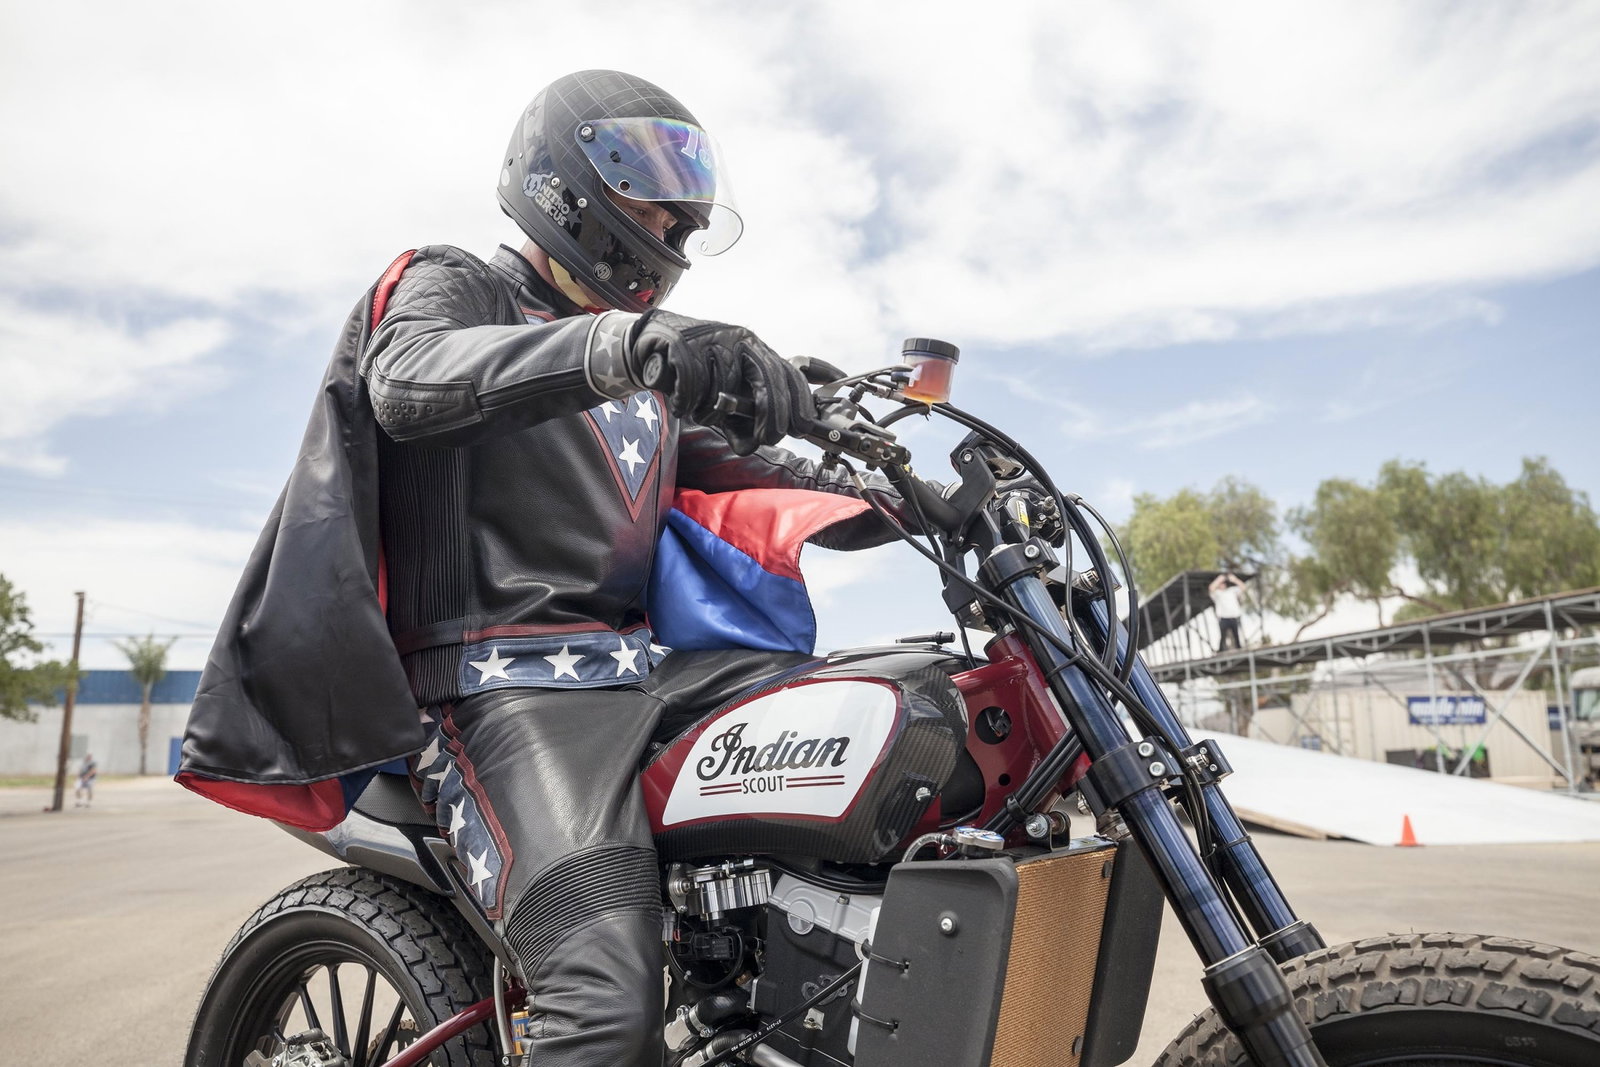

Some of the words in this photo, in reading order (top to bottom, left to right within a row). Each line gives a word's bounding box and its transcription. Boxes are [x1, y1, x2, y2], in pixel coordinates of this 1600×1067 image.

[534, 192, 568, 227] CIRCUS
[540, 182, 570, 215] NITRO
[696, 722, 851, 781] Indian
[742, 775, 785, 794] SCOUT
